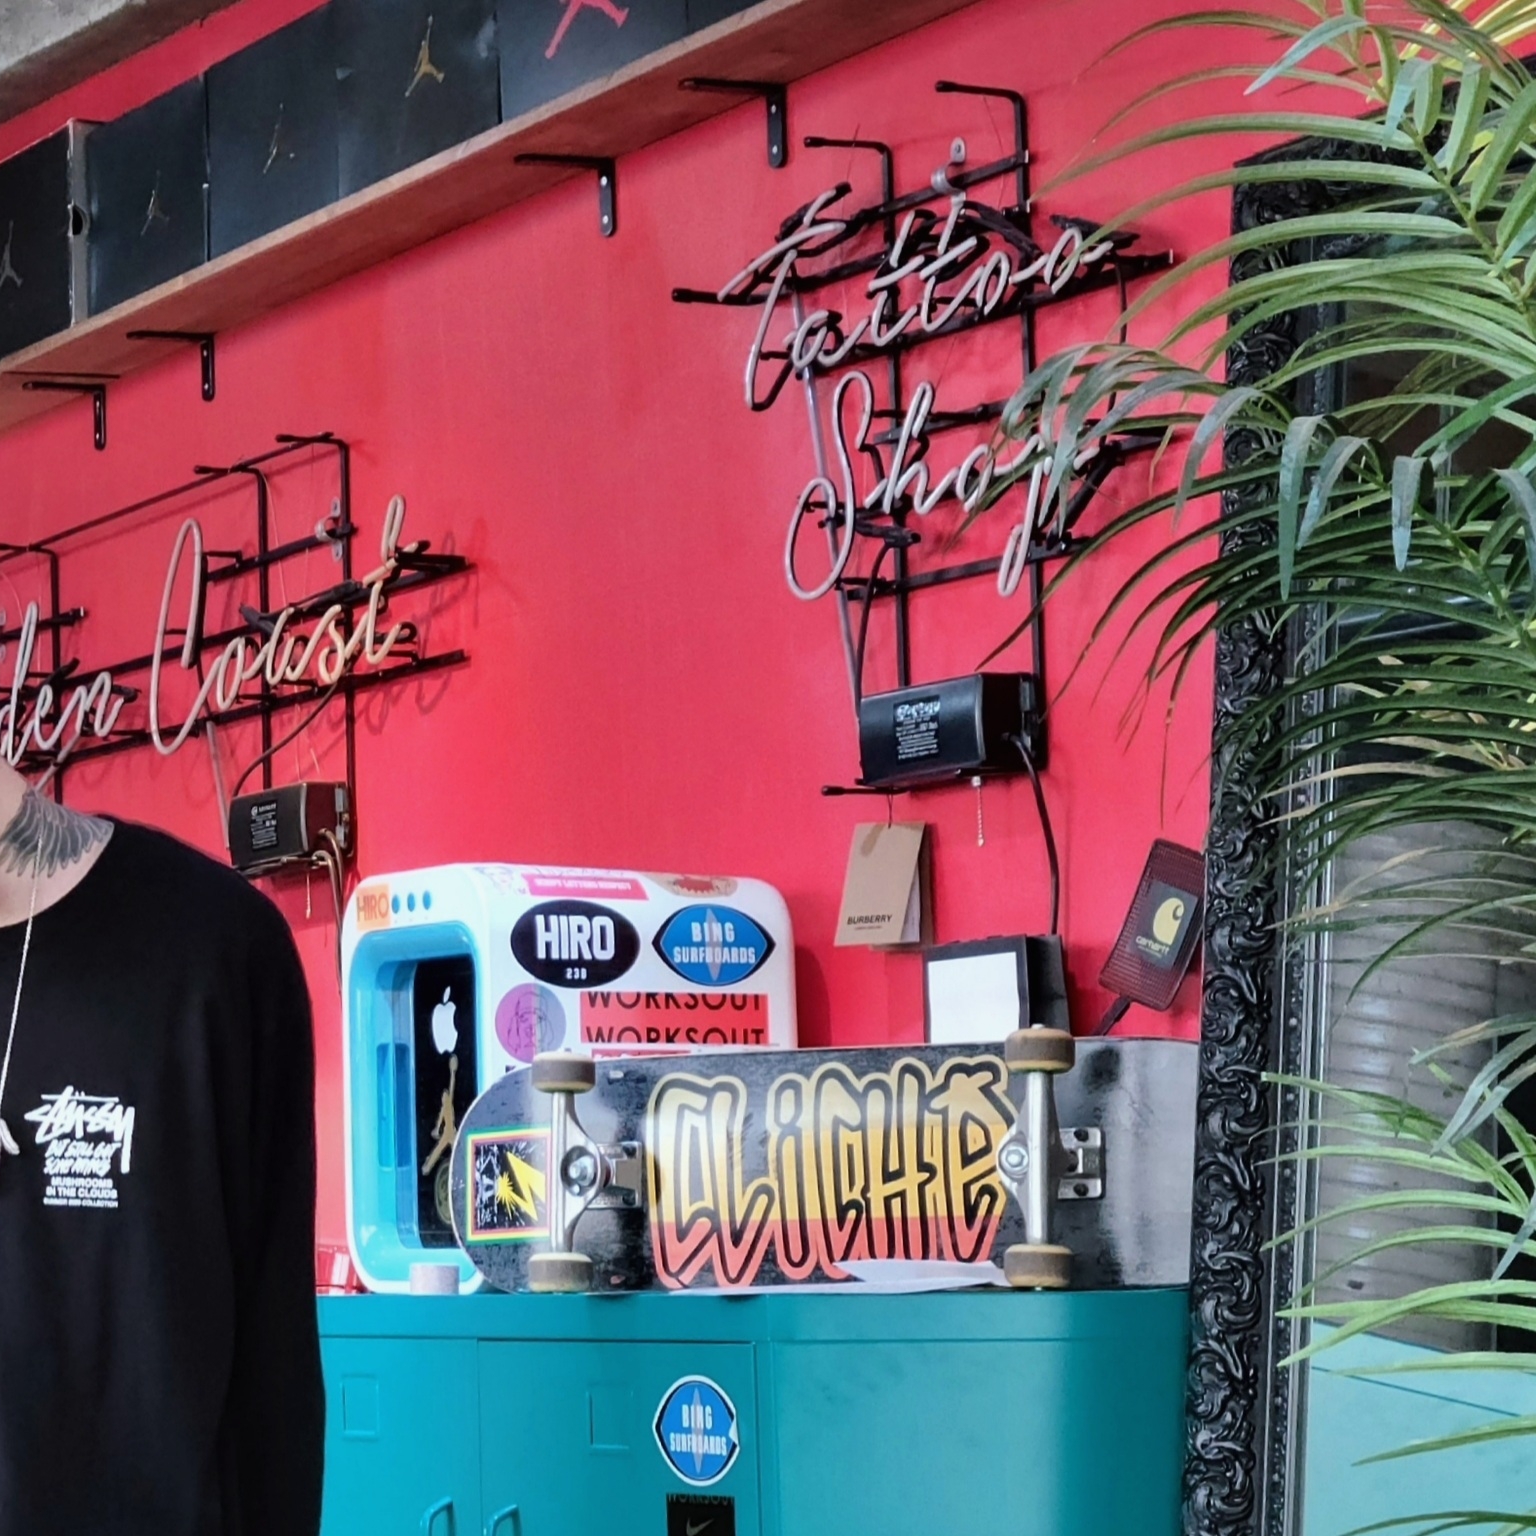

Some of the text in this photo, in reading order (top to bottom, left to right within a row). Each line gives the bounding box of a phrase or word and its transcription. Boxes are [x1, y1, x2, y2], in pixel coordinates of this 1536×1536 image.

[718, 187, 1114, 411] Tattoo
[690, 921, 736, 943] BING
[846, 913, 893, 926] BURBERRY
[535, 913, 616, 961] HIRO
[672, 945, 757, 965] SURFBOARDS
[681, 1404, 713, 1430] BING
[669, 1432, 728, 1457] SURFBOARDS
